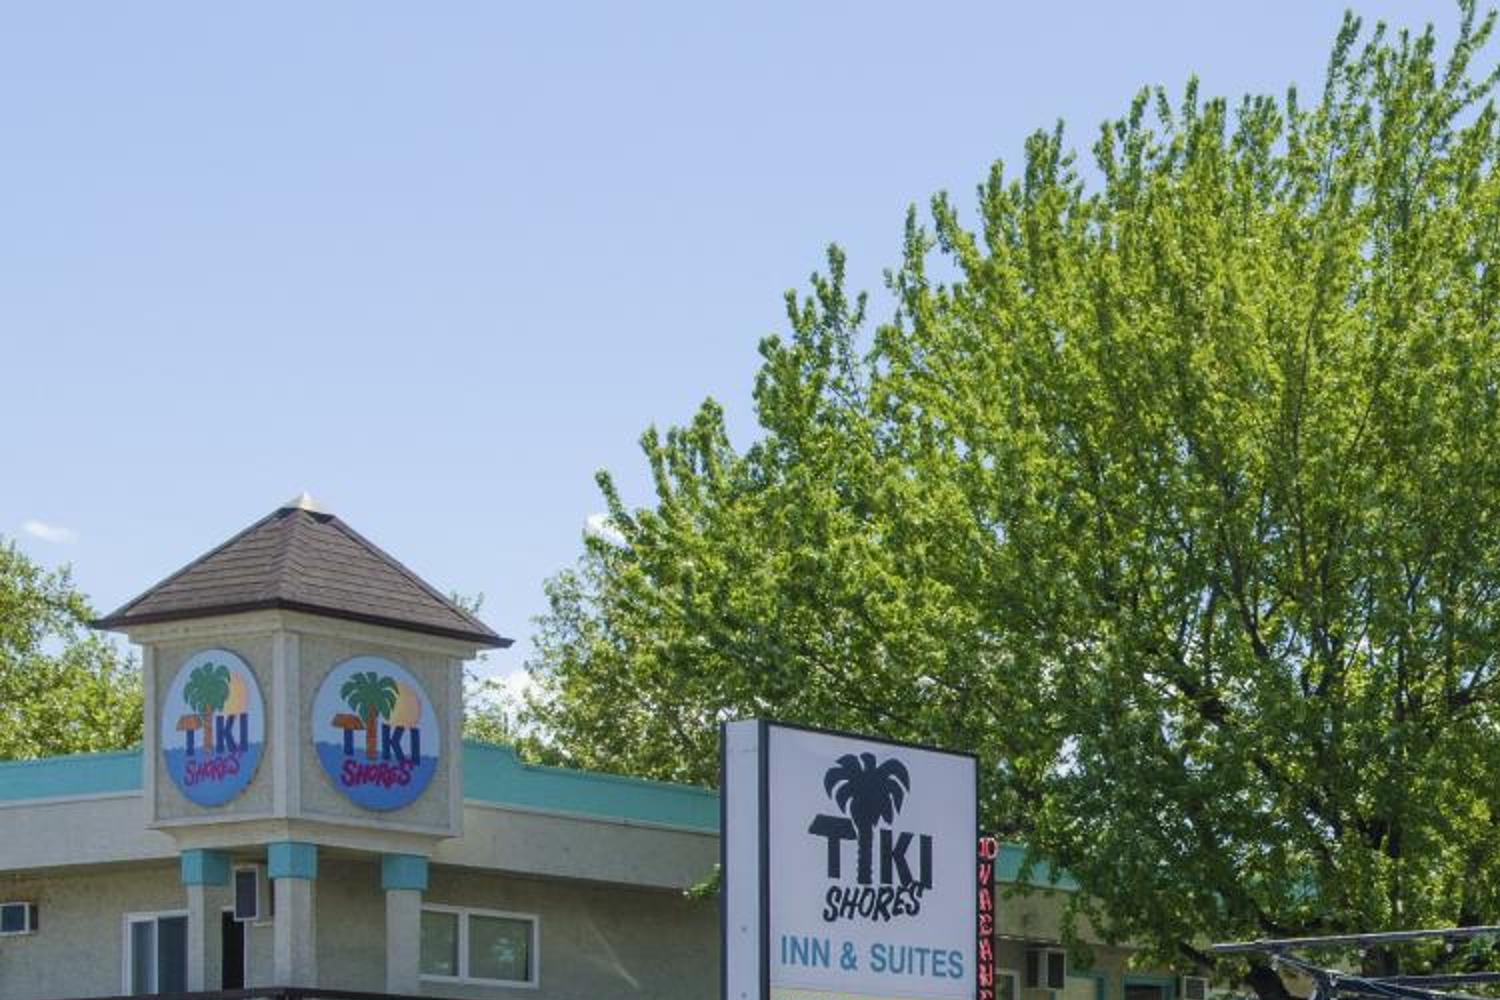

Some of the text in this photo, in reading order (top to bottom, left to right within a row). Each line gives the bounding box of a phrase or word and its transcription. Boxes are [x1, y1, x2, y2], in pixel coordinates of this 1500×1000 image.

[176, 712, 249, 756] TIKI
[331, 712, 421, 766] TIKI
[184, 749, 241, 786] SHORES
[341, 758, 416, 790] SHORES
[808, 813, 933, 890] TIKI
[823, 880, 923, 922] SHORES
[781, 934, 964, 979] INN & SUITES
